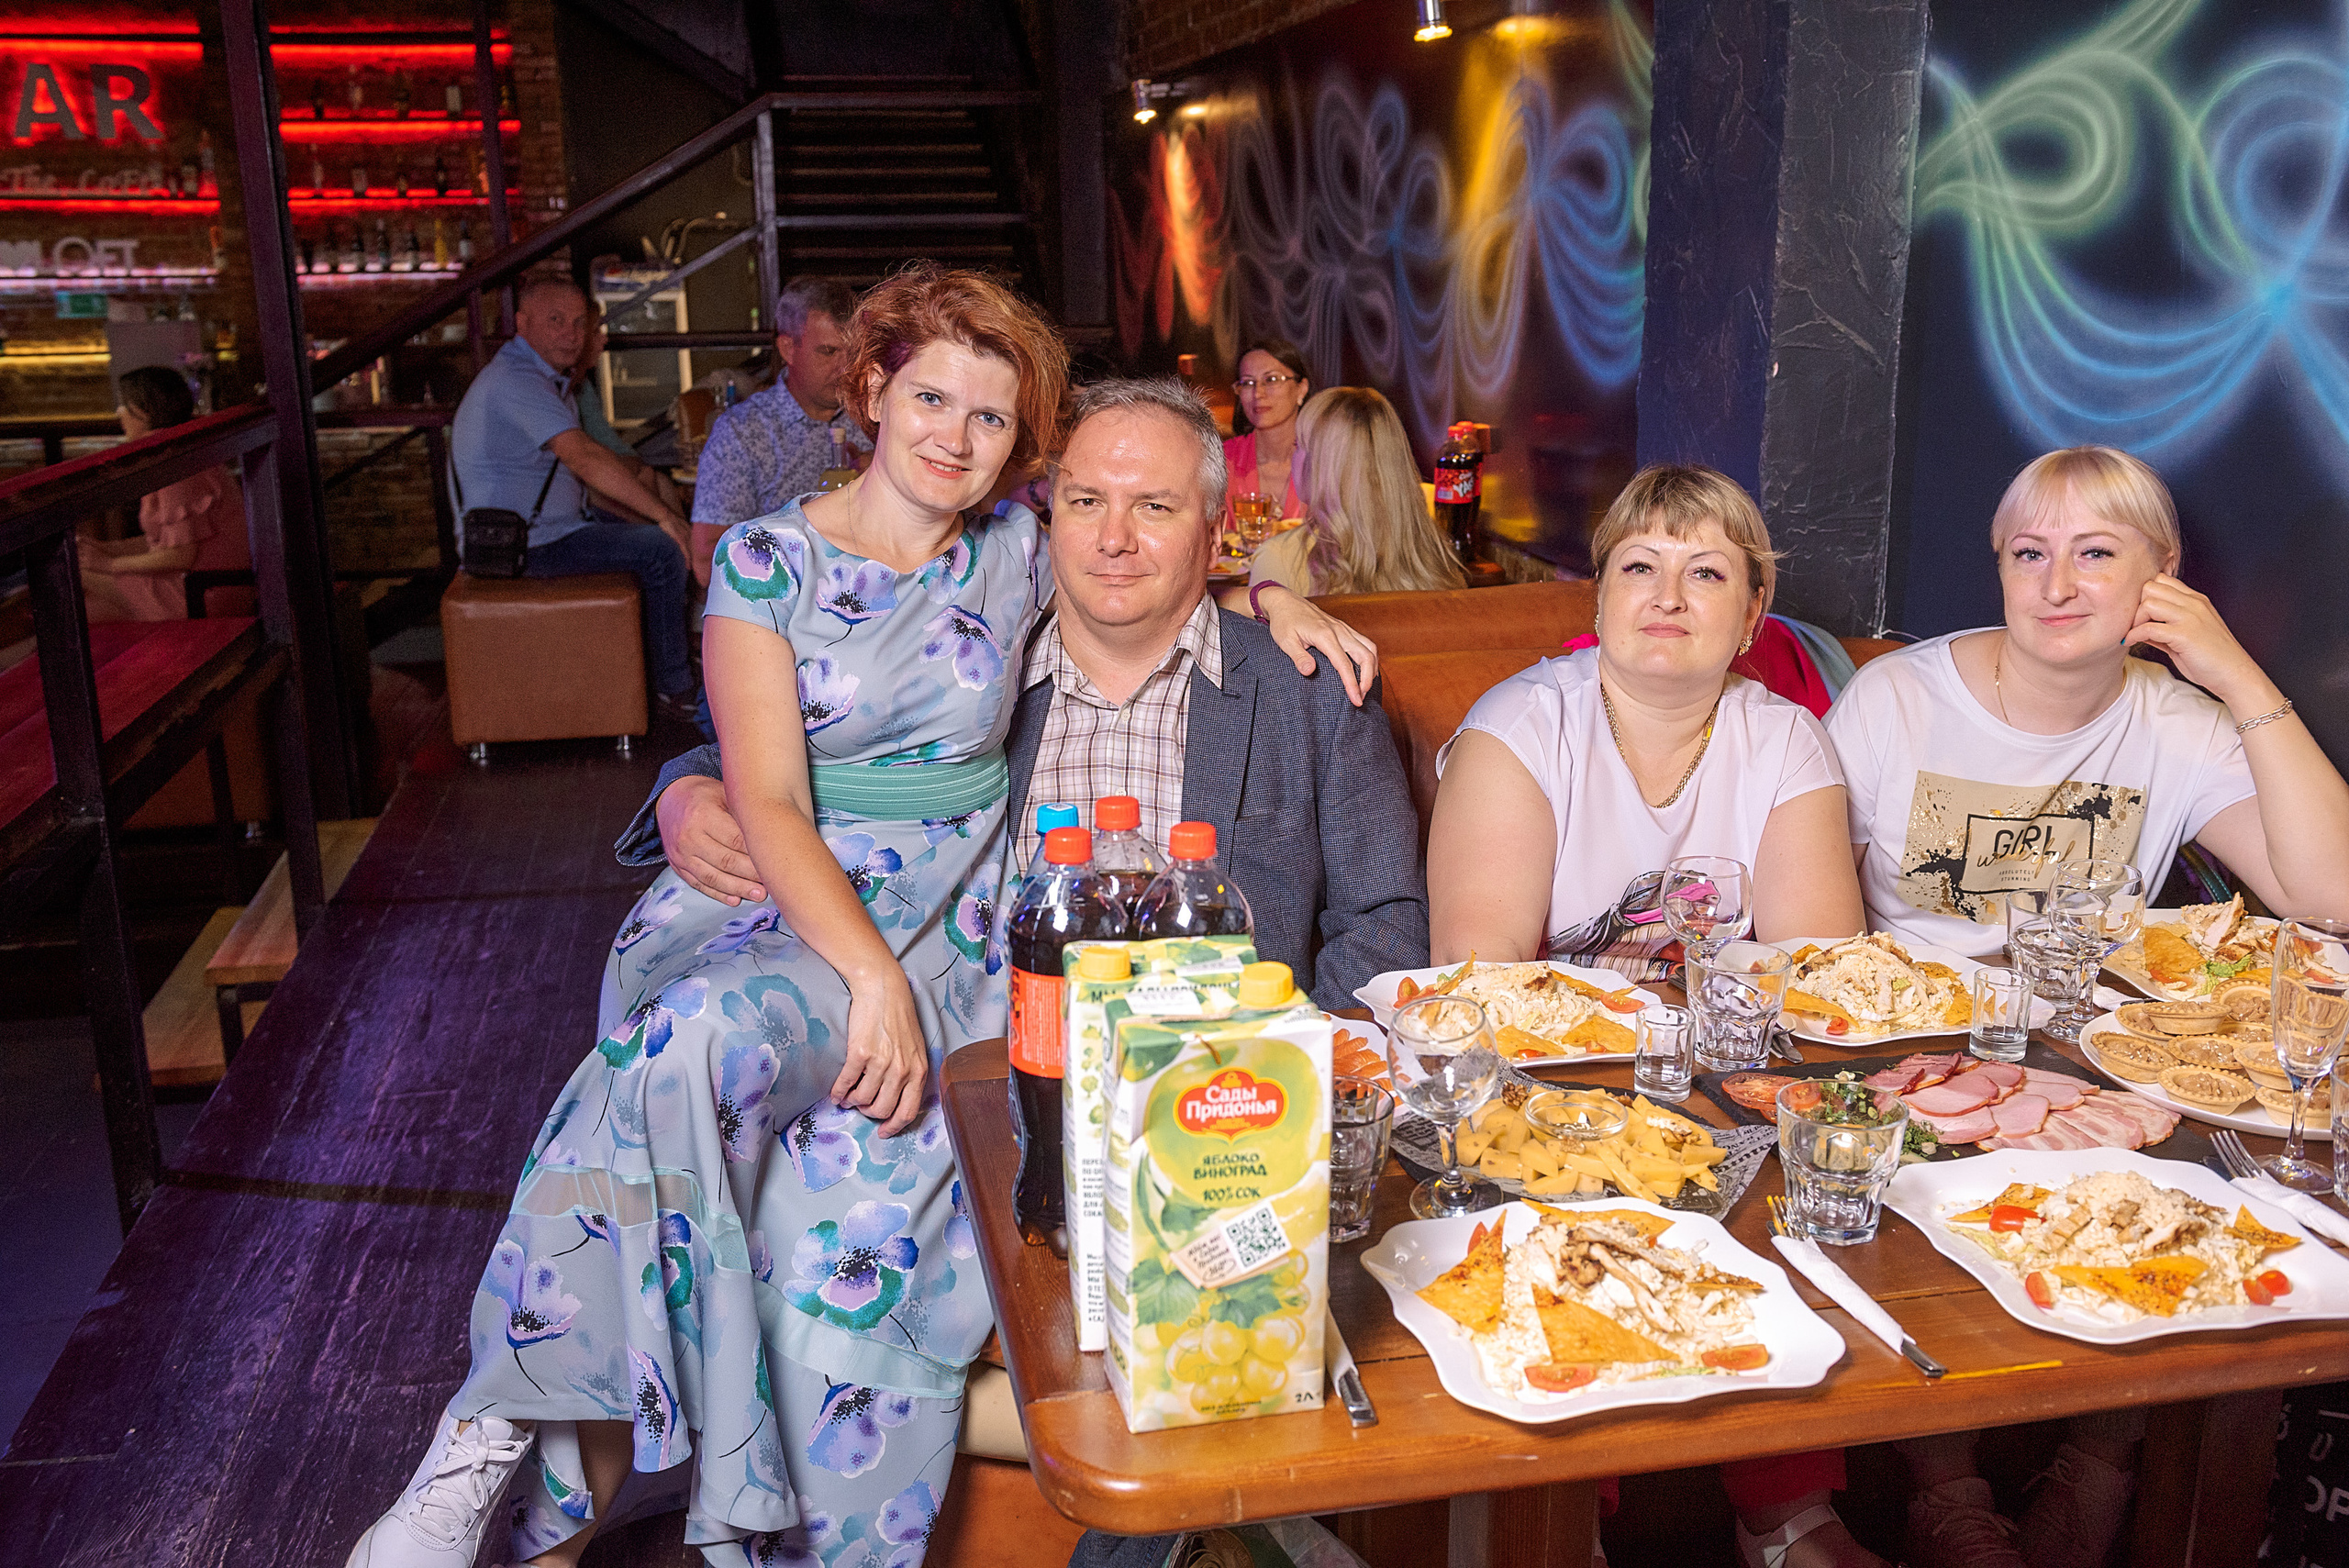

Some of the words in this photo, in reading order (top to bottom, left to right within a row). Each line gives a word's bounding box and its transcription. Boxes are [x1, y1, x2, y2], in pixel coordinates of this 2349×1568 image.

[14, 62, 165, 139] AR
[1994, 825, 2058, 860] GIRL
[1205, 1085, 1257, 1103] Сады
[1186, 1099, 1276, 1123] Придонья
[1203, 1152, 1260, 1165] ЯБЛОКО
[1194, 1163, 1268, 1180] ВИНОГРАД
[1203, 1185, 1233, 1201] 100%
[1235, 1187, 1261, 1199] СОК
